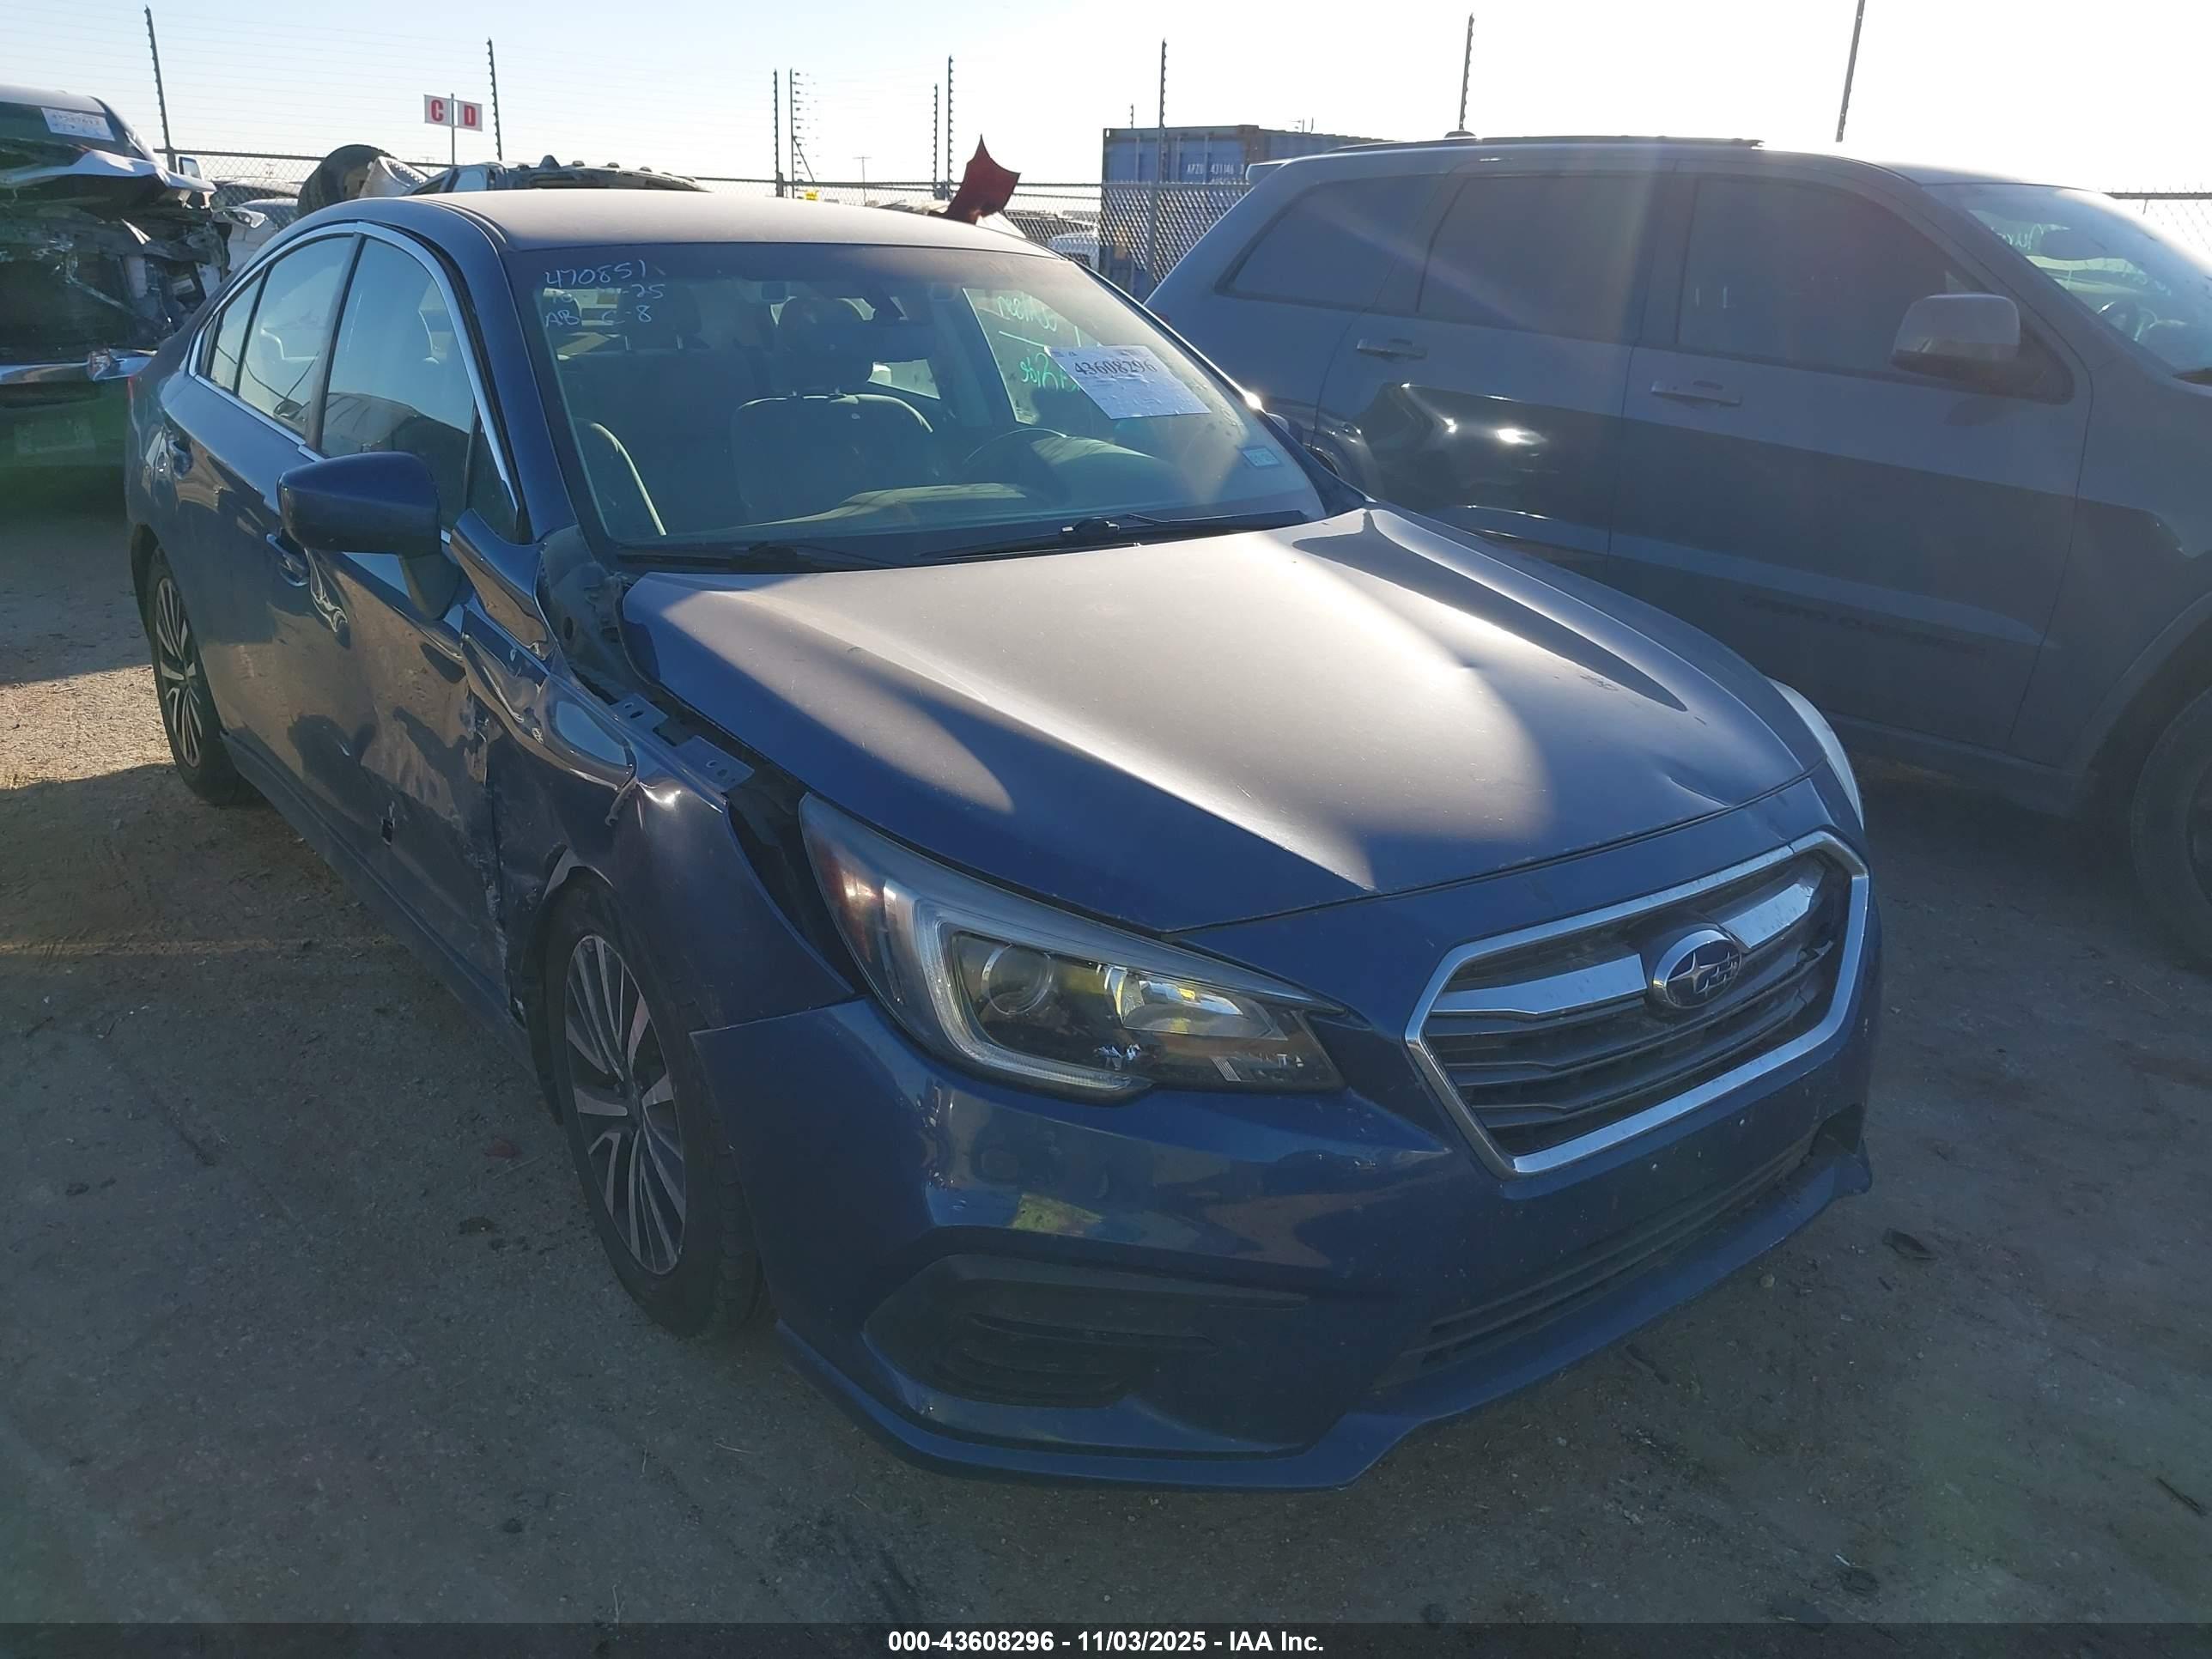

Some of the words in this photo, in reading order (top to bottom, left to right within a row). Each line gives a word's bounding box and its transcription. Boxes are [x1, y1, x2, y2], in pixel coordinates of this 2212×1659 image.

[431, 99, 444, 122] C
[464, 104, 476, 127] D
[1073, 360, 1158, 376] 43608296
